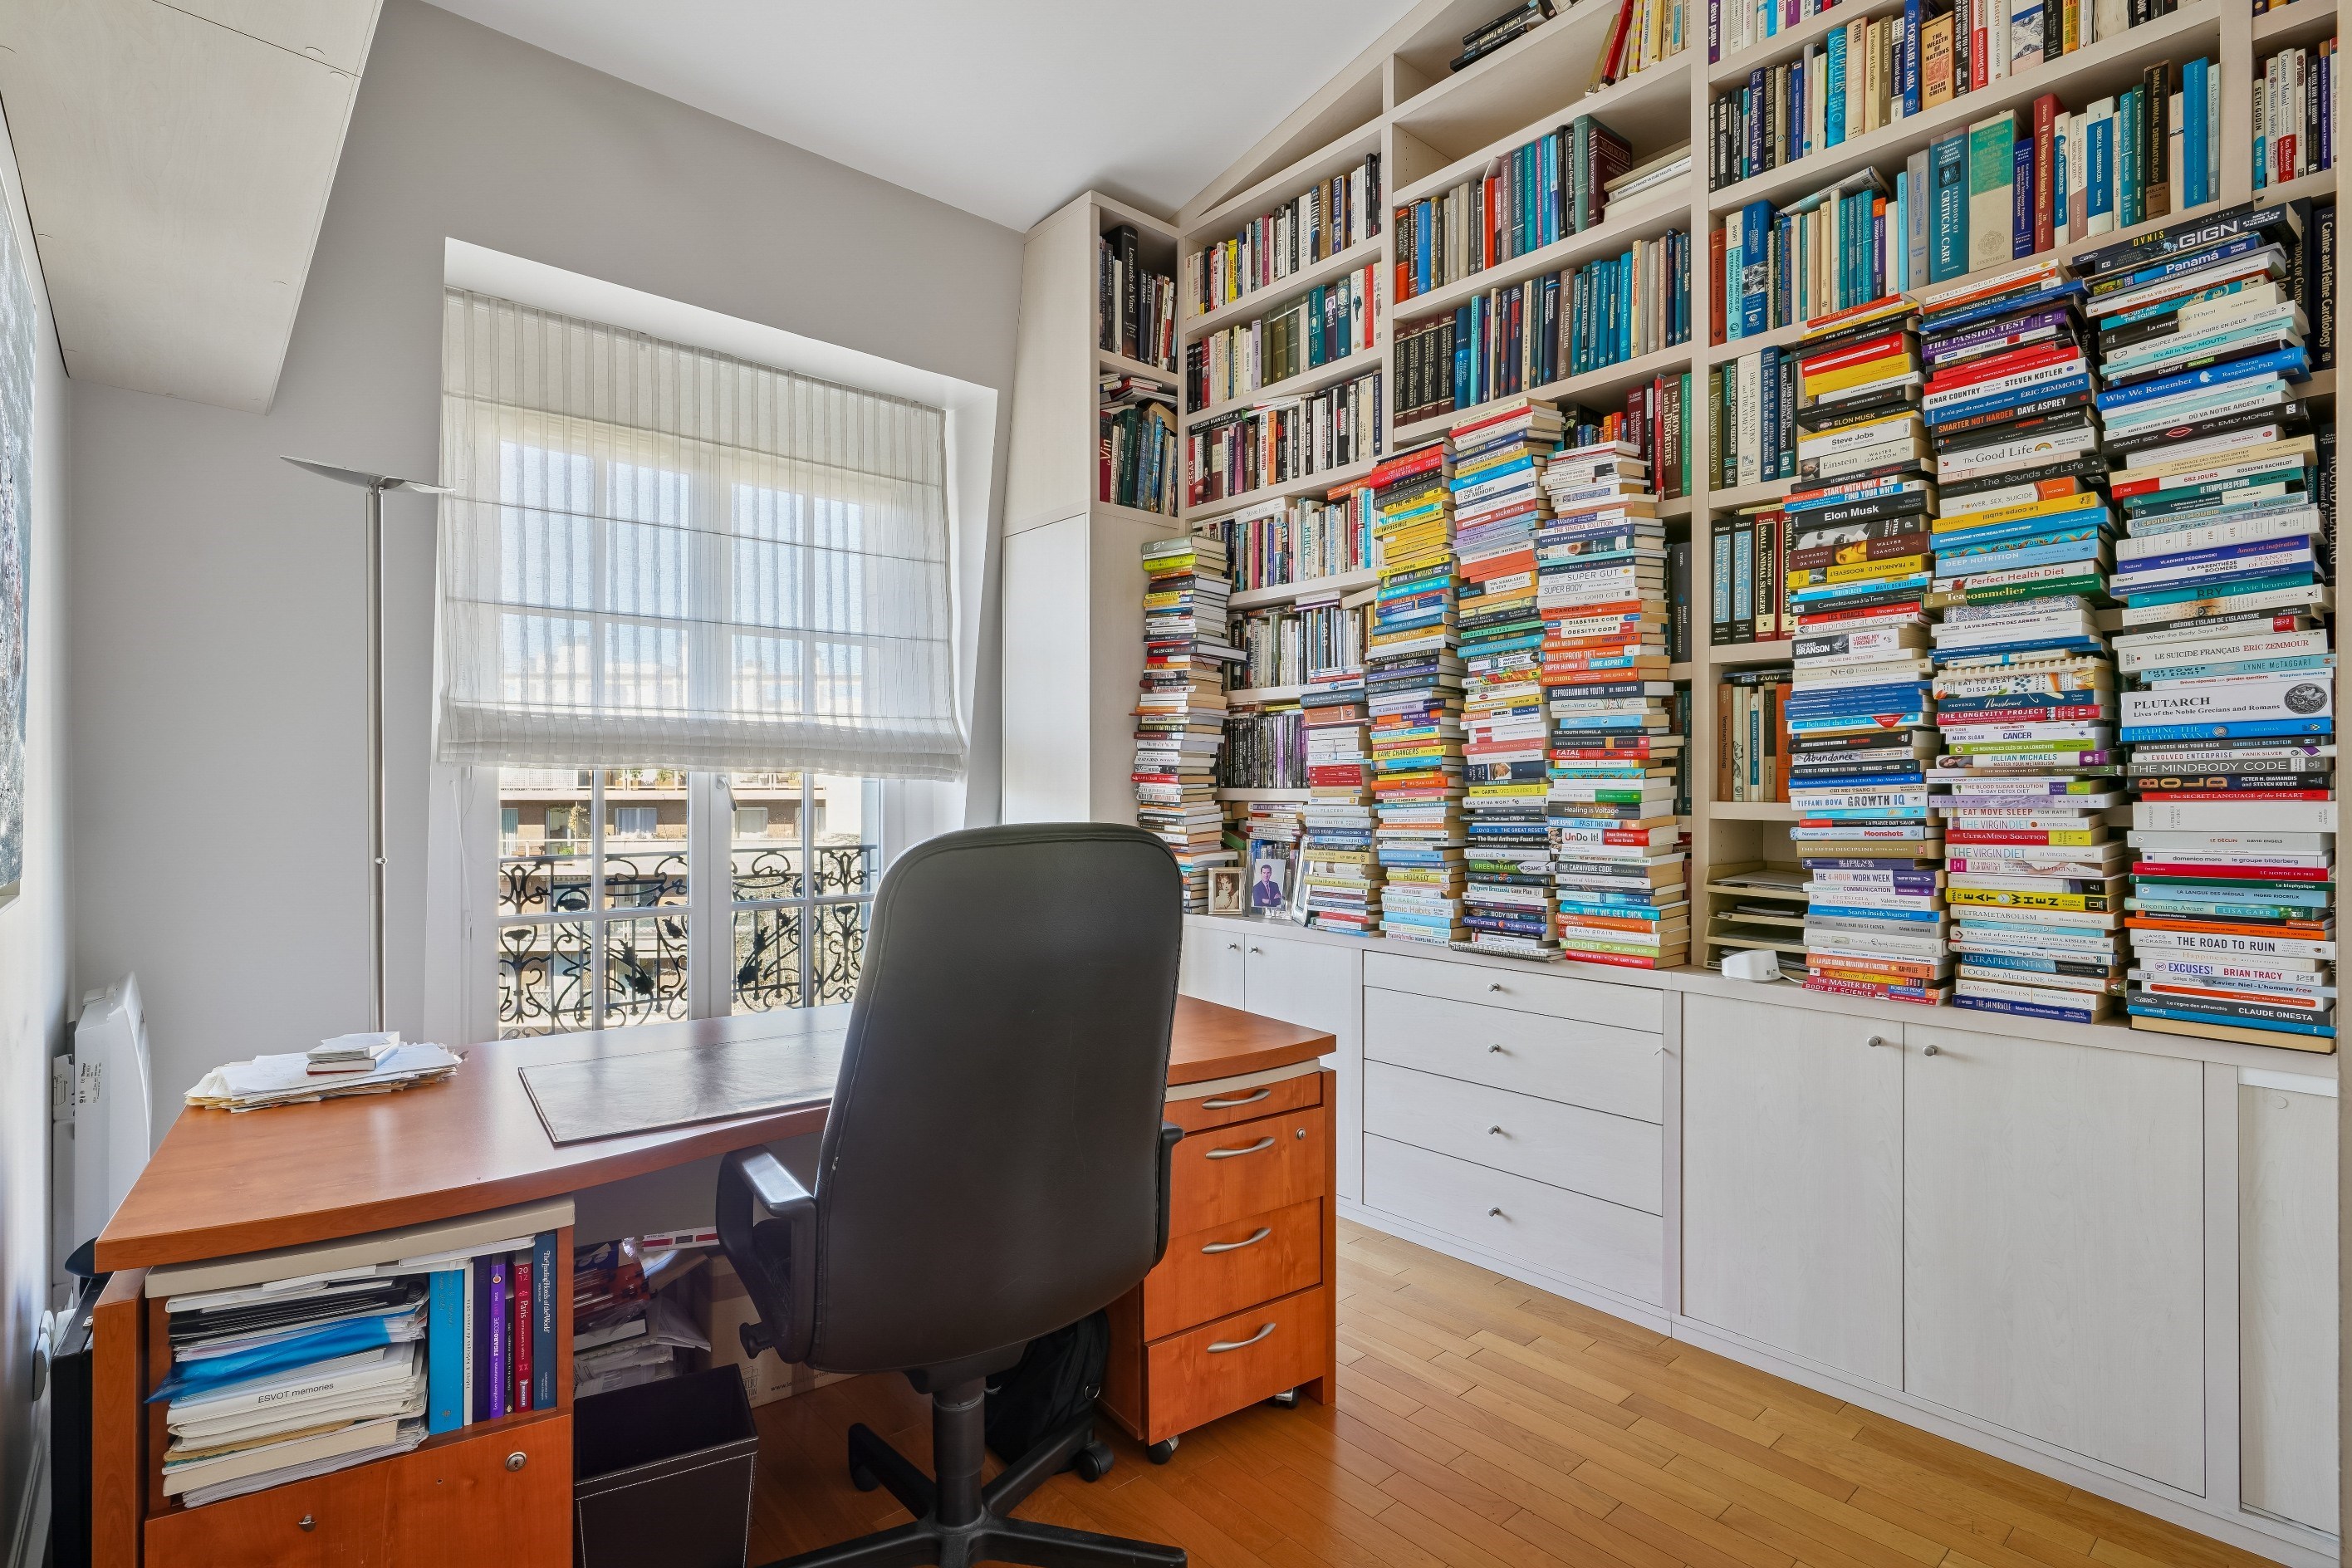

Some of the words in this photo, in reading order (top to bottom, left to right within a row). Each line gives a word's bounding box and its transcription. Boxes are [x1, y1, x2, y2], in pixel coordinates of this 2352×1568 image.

[1835, 32, 1847, 56] TOM
[1927, 35, 1948, 49] WEALTH
[1933, 32, 1943, 40] THE
[1906, 22, 1915, 69] PORTABLE
[1926, 47, 1949, 61] NATIONS
[1834, 56, 1846, 92] PETERS
[1906, 69, 1915, 91] MBA
[1929, 86, 1947, 96] SMITH
[1930, 81, 1946, 91] ADAM
[1941, 190, 1950, 237] CRITICAL
[1953, 224, 1958, 233] OF
[2178, 220, 2238, 248] GIGN
[2322, 221, 2332, 254] Canine
[1941, 241, 1950, 264] CARE
[1977, 255, 2006, 266] OXFORD
[2165, 249, 2219, 274] Panamá
[2321, 254, 2332, 271] and
[1129, 283, 1135, 292] da
[2321, 272, 2333, 297] Feline
[2320, 299, 2333, 347] Cardiology
[1928, 341, 1948, 350] THE
[1953, 326, 1997, 344] PASSION
[1999, 320, 2026, 335] TEST
[2005, 375, 2032, 387] STEVEN
[2035, 367, 2063, 380] KOTLER
[1929, 395, 1947, 404] GNAR
[1949, 387, 1980, 400] COUNTRY
[2021, 390, 2039, 399] ÉRIC
[2041, 378, 2084, 394] ZEMMOUR
[2105, 390, 2126, 404] Why
[2129, 388, 2143, 397] We
[2145, 378, 2193, 393] Remember
[2017, 404, 2036, 415] DAVE
[2038, 397, 2066, 411] ASPREY
[1191, 420, 1210, 431] NELSON
[1212, 412, 1233, 425] MANDELA
[1672, 402, 1680, 435] ELBOW
[1834, 416, 1853, 426] ELON
[1855, 413, 1875, 423] MUSK
[1938, 419, 1970, 434] SMARTER
[1971, 415, 1985, 426] NOT
[1986, 409, 2013, 423] HARDER
[2203, 421, 2217, 429] DR.
[2218, 417, 2242, 426] EMILY
[2242, 410, 2275, 421] MORSE
[1664, 413, 1672, 467] DISORDERS
[1831, 434, 1853, 446] Steve
[1855, 431, 1874, 441] Jobs
[2113, 439, 2140, 448] SMART
[2142, 434, 2159, 443] SEX
[1100, 439, 1112, 460] Vin
[1976, 450, 2005, 463] Good
[2009, 444, 2033, 457] Life
[1982, 478, 2000, 487] The
[2004, 471, 2041, 483] Sounds
[2045, 467, 2058, 475] of
[2060, 462, 2084, 473] Life
[2237, 465, 2264, 473] ROSELYNE
[2264, 459, 2293, 470] BACHELOT
[2197, 472, 2218, 481] JOURS
[1823, 487, 1843, 497] START
[1845, 483, 1860, 493] WITH
[1862, 479, 1878, 490] WHY
[1844, 492, 1860, 501] FIND
[1860, 488, 1878, 498] YOUR
[1879, 485, 1894, 495] WHY
[1495, 505, 1524, 517] sickening
[1825, 510, 1848, 522] Elon
[1850, 505, 1879, 517] Musk
[1971, 576, 2004, 586] Perfect
[2008, 572, 2040, 582] Health
[2044, 568, 2065, 576] Diet
[2134, 696, 2211, 709] PLUTARCH
[2198, 706, 2232, 714] Grecians
[2131, 765, 2159, 773] THE
[2163, 762, 2239, 772] MINDBODY
[2243, 761, 2287, 771] CODE
[1848, 796, 1890, 806] GROWTH
[1894, 794, 1905, 805] IQ
[1815, 873, 1826, 881] THE
[1872, 874, 1890, 883] WEEK
[1384, 904, 1408, 913] Atomic
[1410, 906, 1431, 914] Habits
[1958, 909, 2036, 920] ULTRAMETABOLISM
[2177, 936, 2198, 946] THE
[2200, 938, 2227, 948] ROAD
[2232, 939, 2245, 949] TO
[2250, 940, 2276, 952] RUIN
[2168, 963, 2213, 974] EXCUSES!
[2223, 968, 2251, 978] BRIAN
[2253, 970, 2282, 980] TRACY
[2238, 1007, 2274, 1017] CLAUDE
[2276, 1012, 2313, 1022] ONESTA
[542, 1250, 551, 1262] The
[541, 1262, 551, 1282] Leading
[520, 1300, 529, 1319] Paris
[258, 1390, 289, 1404] ESVOT
[292, 1382, 334, 1397] memories
